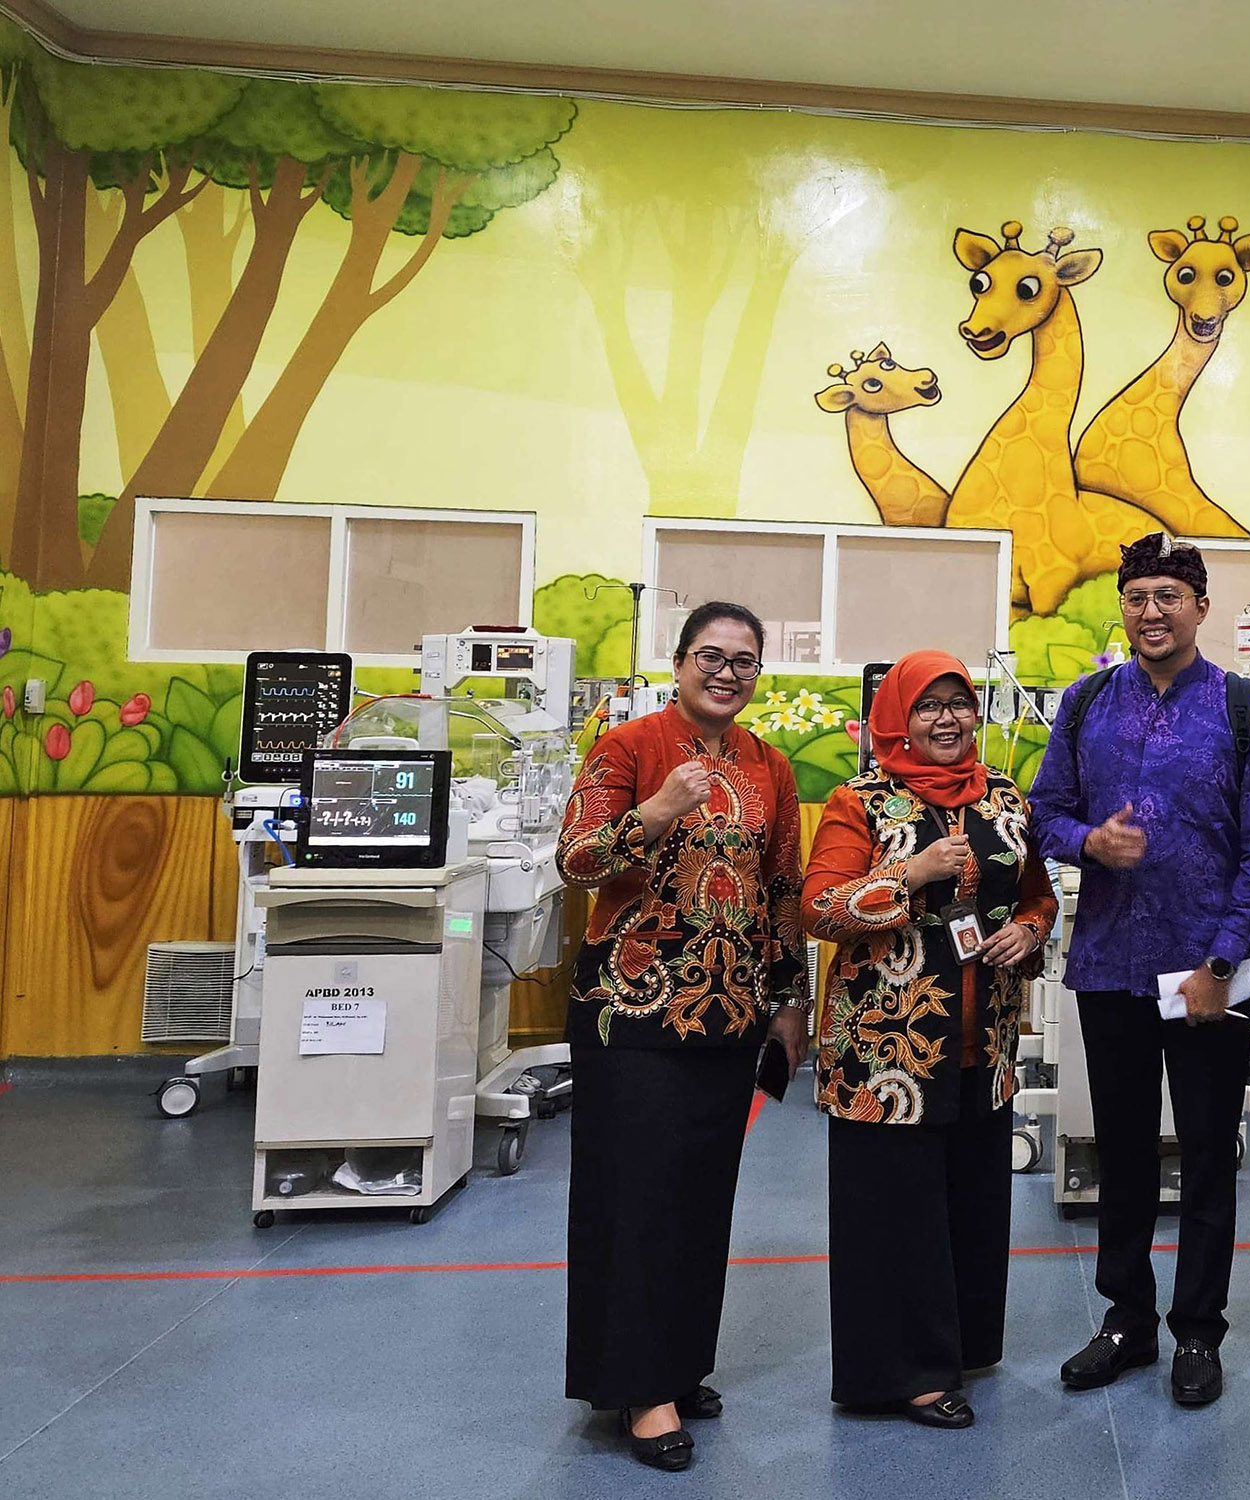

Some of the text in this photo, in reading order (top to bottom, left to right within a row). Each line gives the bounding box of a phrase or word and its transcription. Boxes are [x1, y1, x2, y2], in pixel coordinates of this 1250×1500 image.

[395, 771, 415, 790] 91
[393, 812, 416, 826] 140
[305, 987, 375, 998] APBD 2013
[331, 1003, 360, 1011] BED 7
